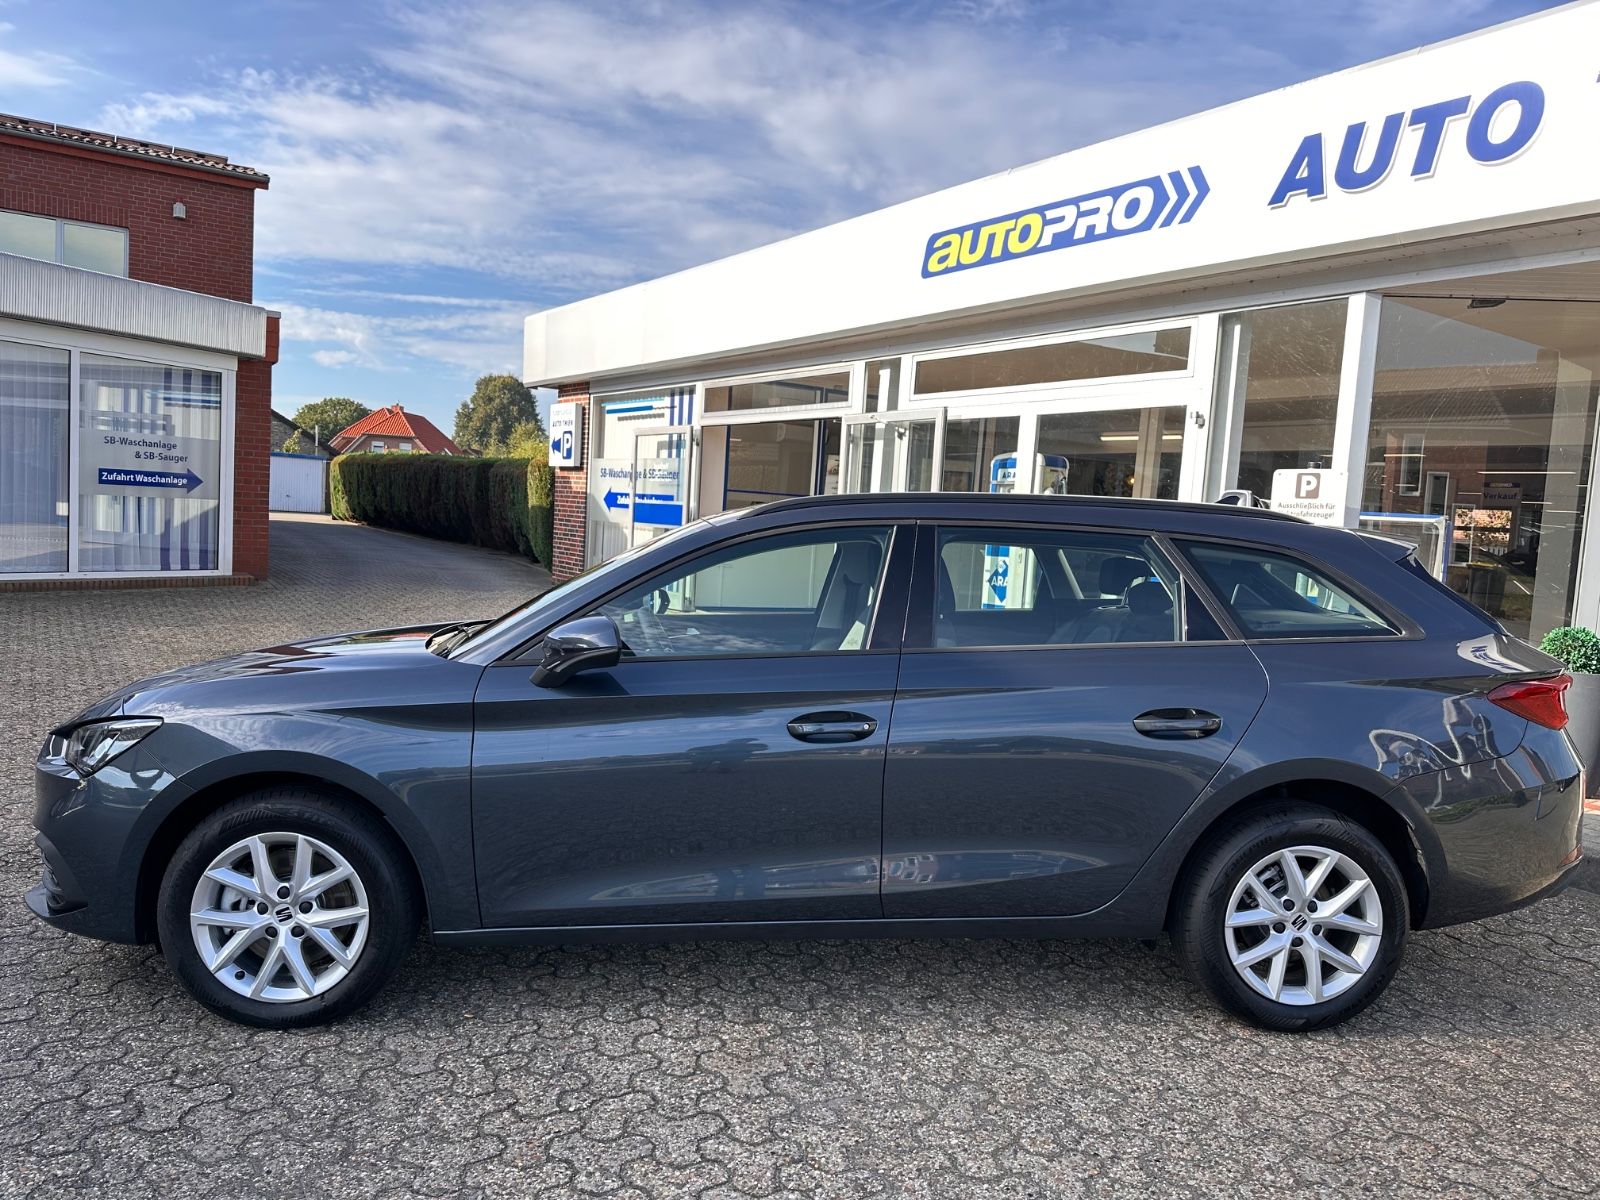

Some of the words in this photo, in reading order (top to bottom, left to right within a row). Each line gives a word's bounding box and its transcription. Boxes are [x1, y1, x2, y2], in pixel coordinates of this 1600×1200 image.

[1267, 80, 1547, 209] AUTO
[103, 436, 177, 451] SB-Waschanlage
[134, 450, 142, 460] &
[143, 451, 188, 464] SB-Sauger
[101, 471, 134, 482] Zufahrt
[135, 473, 188, 486] Waschanlage
[1300, 474, 1318, 498] P
[1277, 502, 1325, 511] Ausschließlich
[1325, 502, 1336, 510] für
